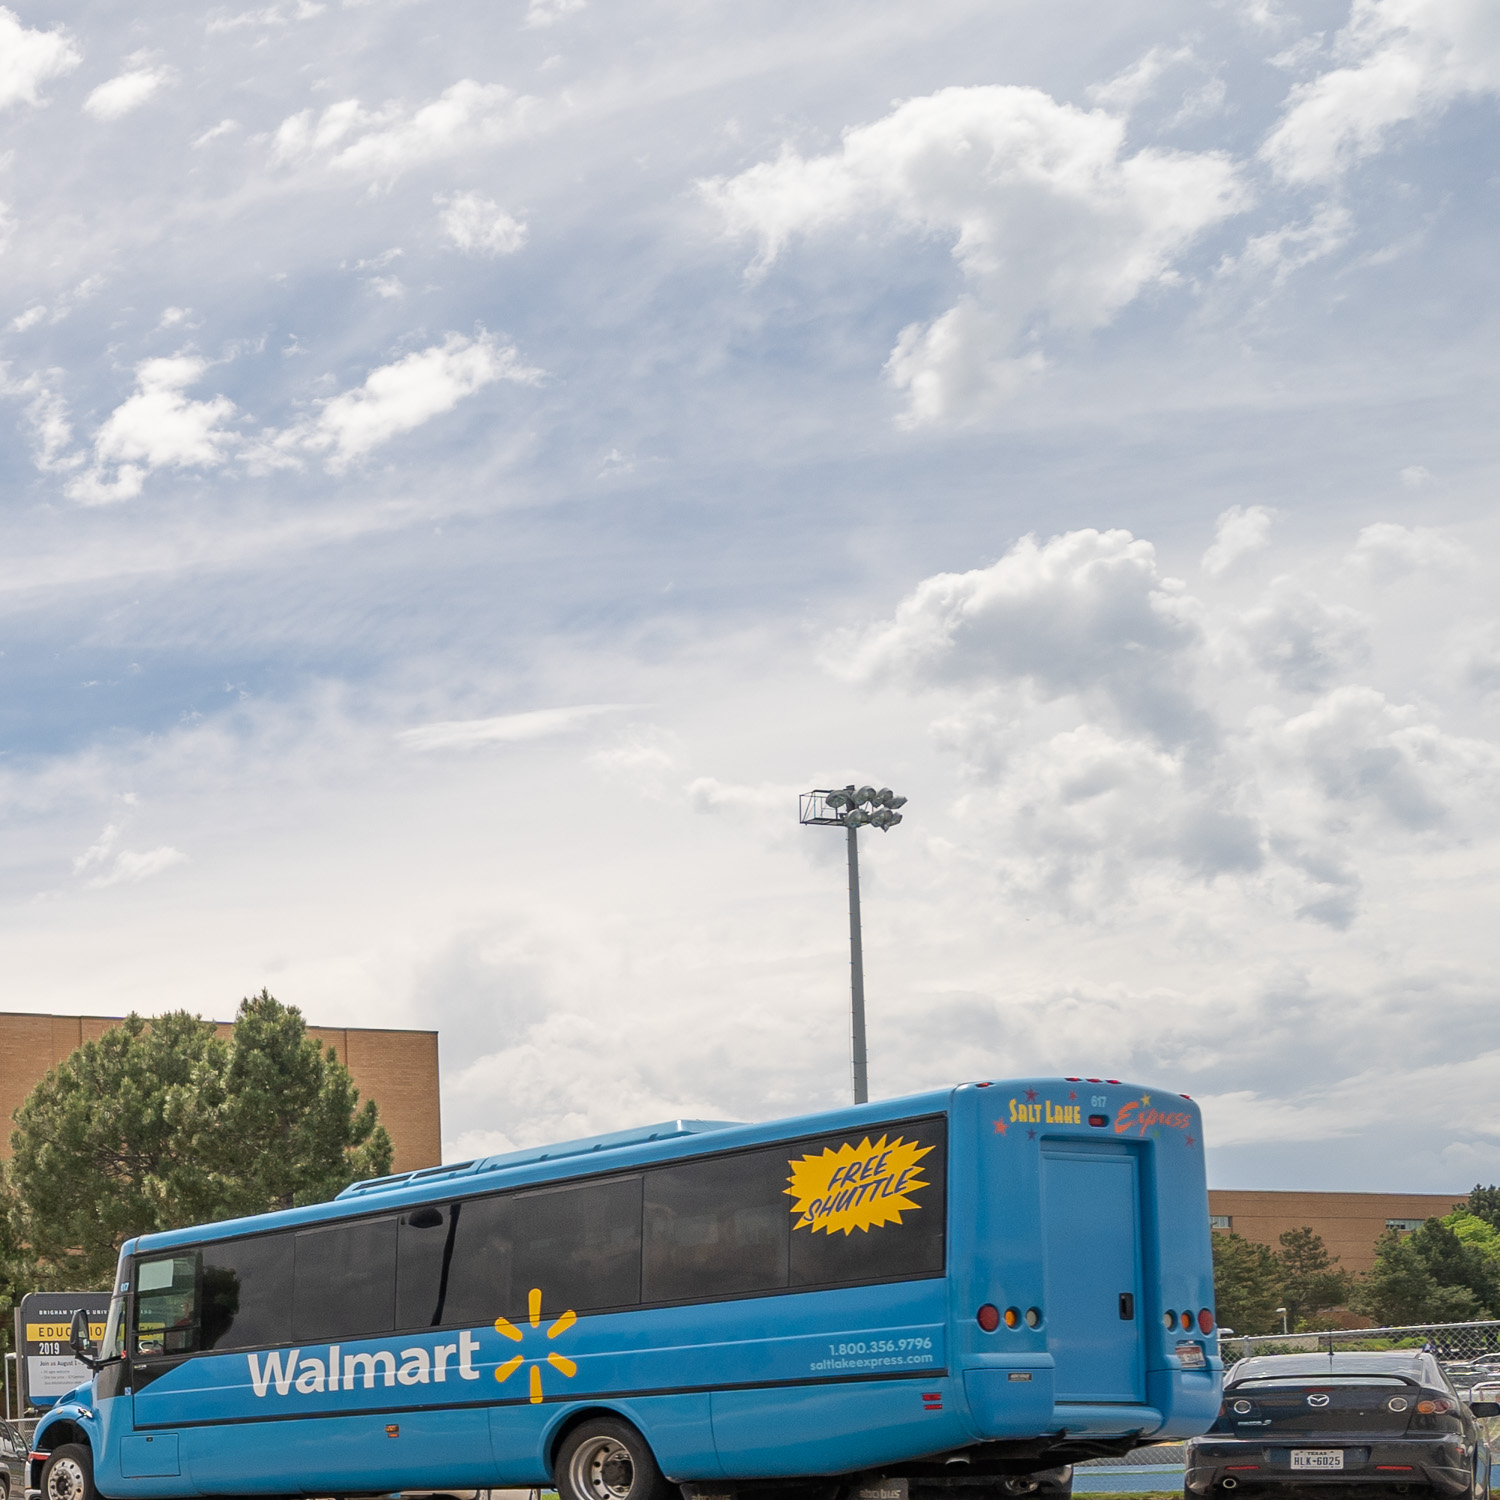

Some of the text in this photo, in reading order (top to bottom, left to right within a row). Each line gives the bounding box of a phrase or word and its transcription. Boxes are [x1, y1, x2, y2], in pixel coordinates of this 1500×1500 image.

[1091, 1095, 1107, 1108] 617
[1114, 1101, 1192, 1137] Express
[827, 1150, 893, 1191] FREE
[803, 1167, 914, 1221] SHUTTLE
[39, 1342, 60, 1355] 2019
[829, 1337, 932, 1356] 1.800.356.9796
[57, 1360, 74, 1368] August
[247, 1330, 481, 1398] Walmart
[810, 1354, 933, 1370] saltlakeexpress.com
